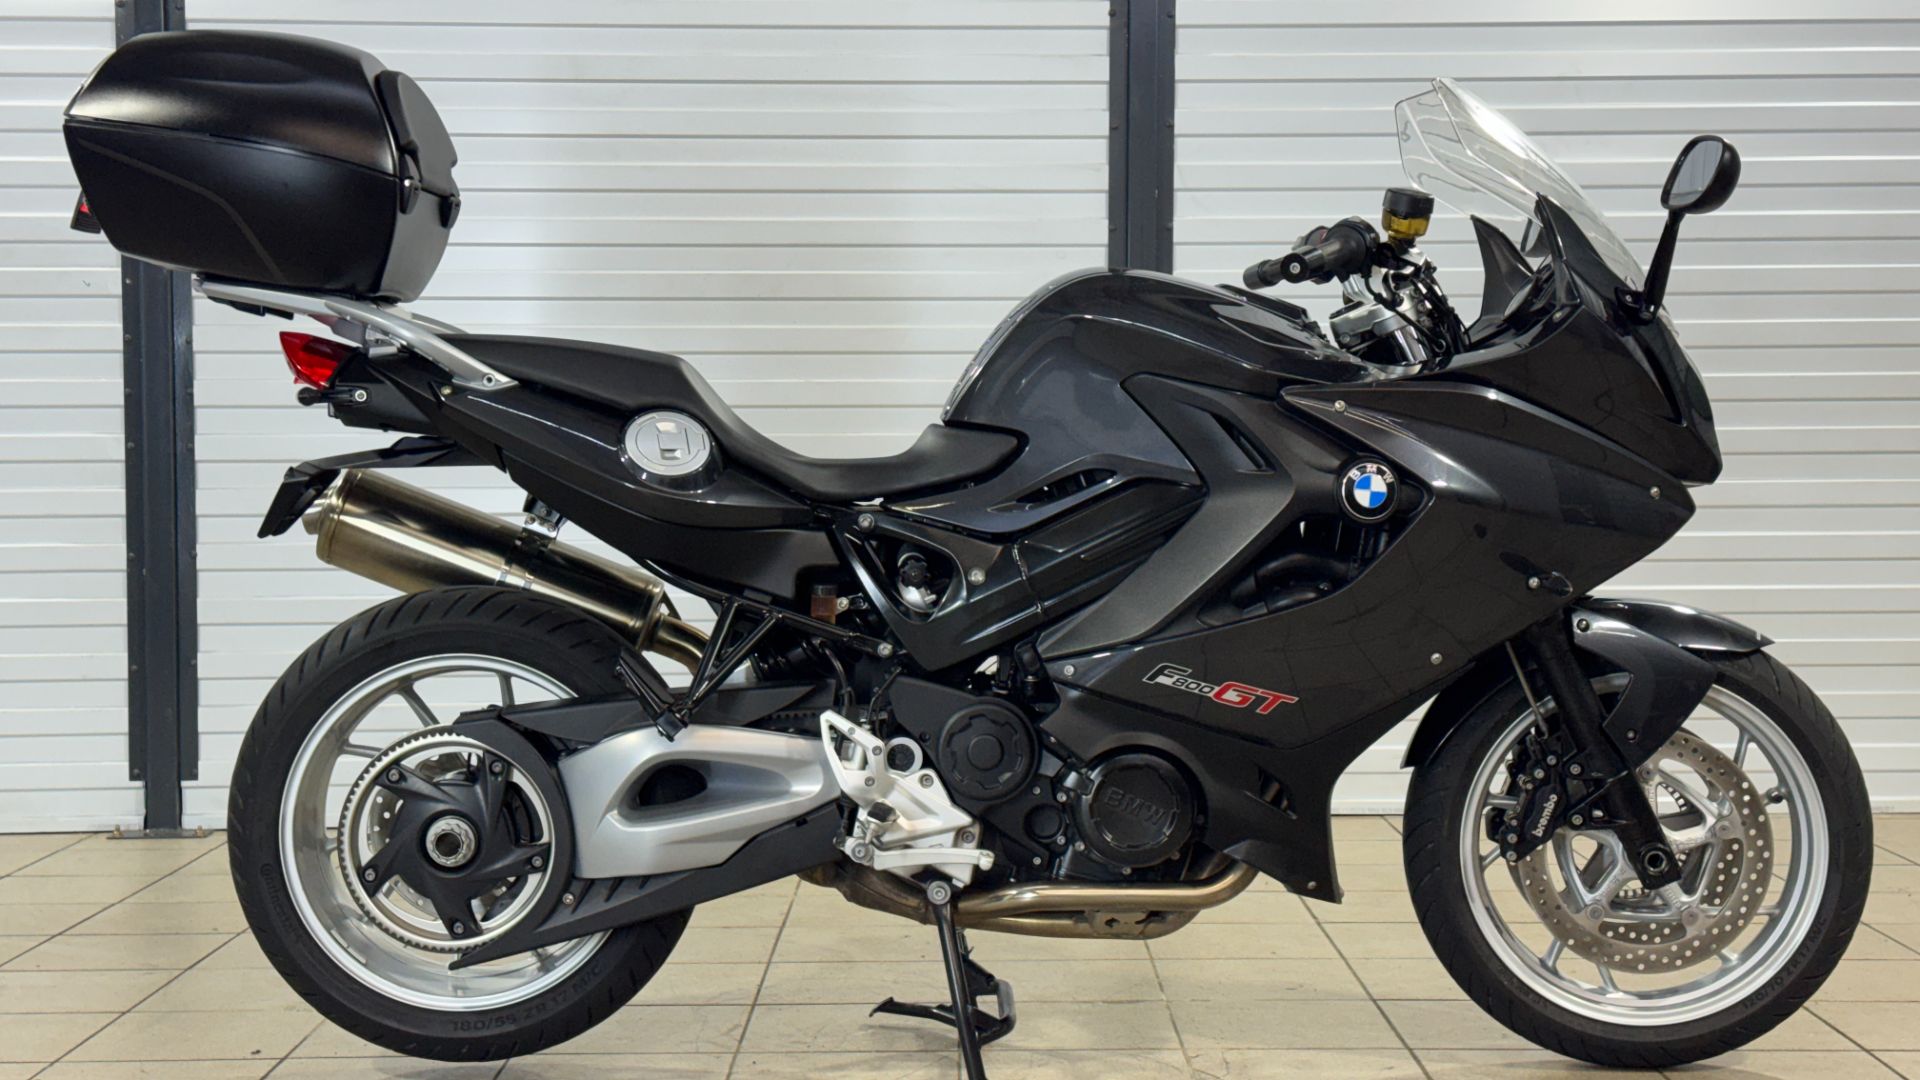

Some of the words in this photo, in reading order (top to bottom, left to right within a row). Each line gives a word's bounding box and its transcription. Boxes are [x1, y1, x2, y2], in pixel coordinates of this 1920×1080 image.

[1350, 463, 1394, 483] BMW
[1104, 787, 1166, 825] BMW
[1532, 794, 1557, 837] brembo
[451, 1014, 517, 1032] 180/55
